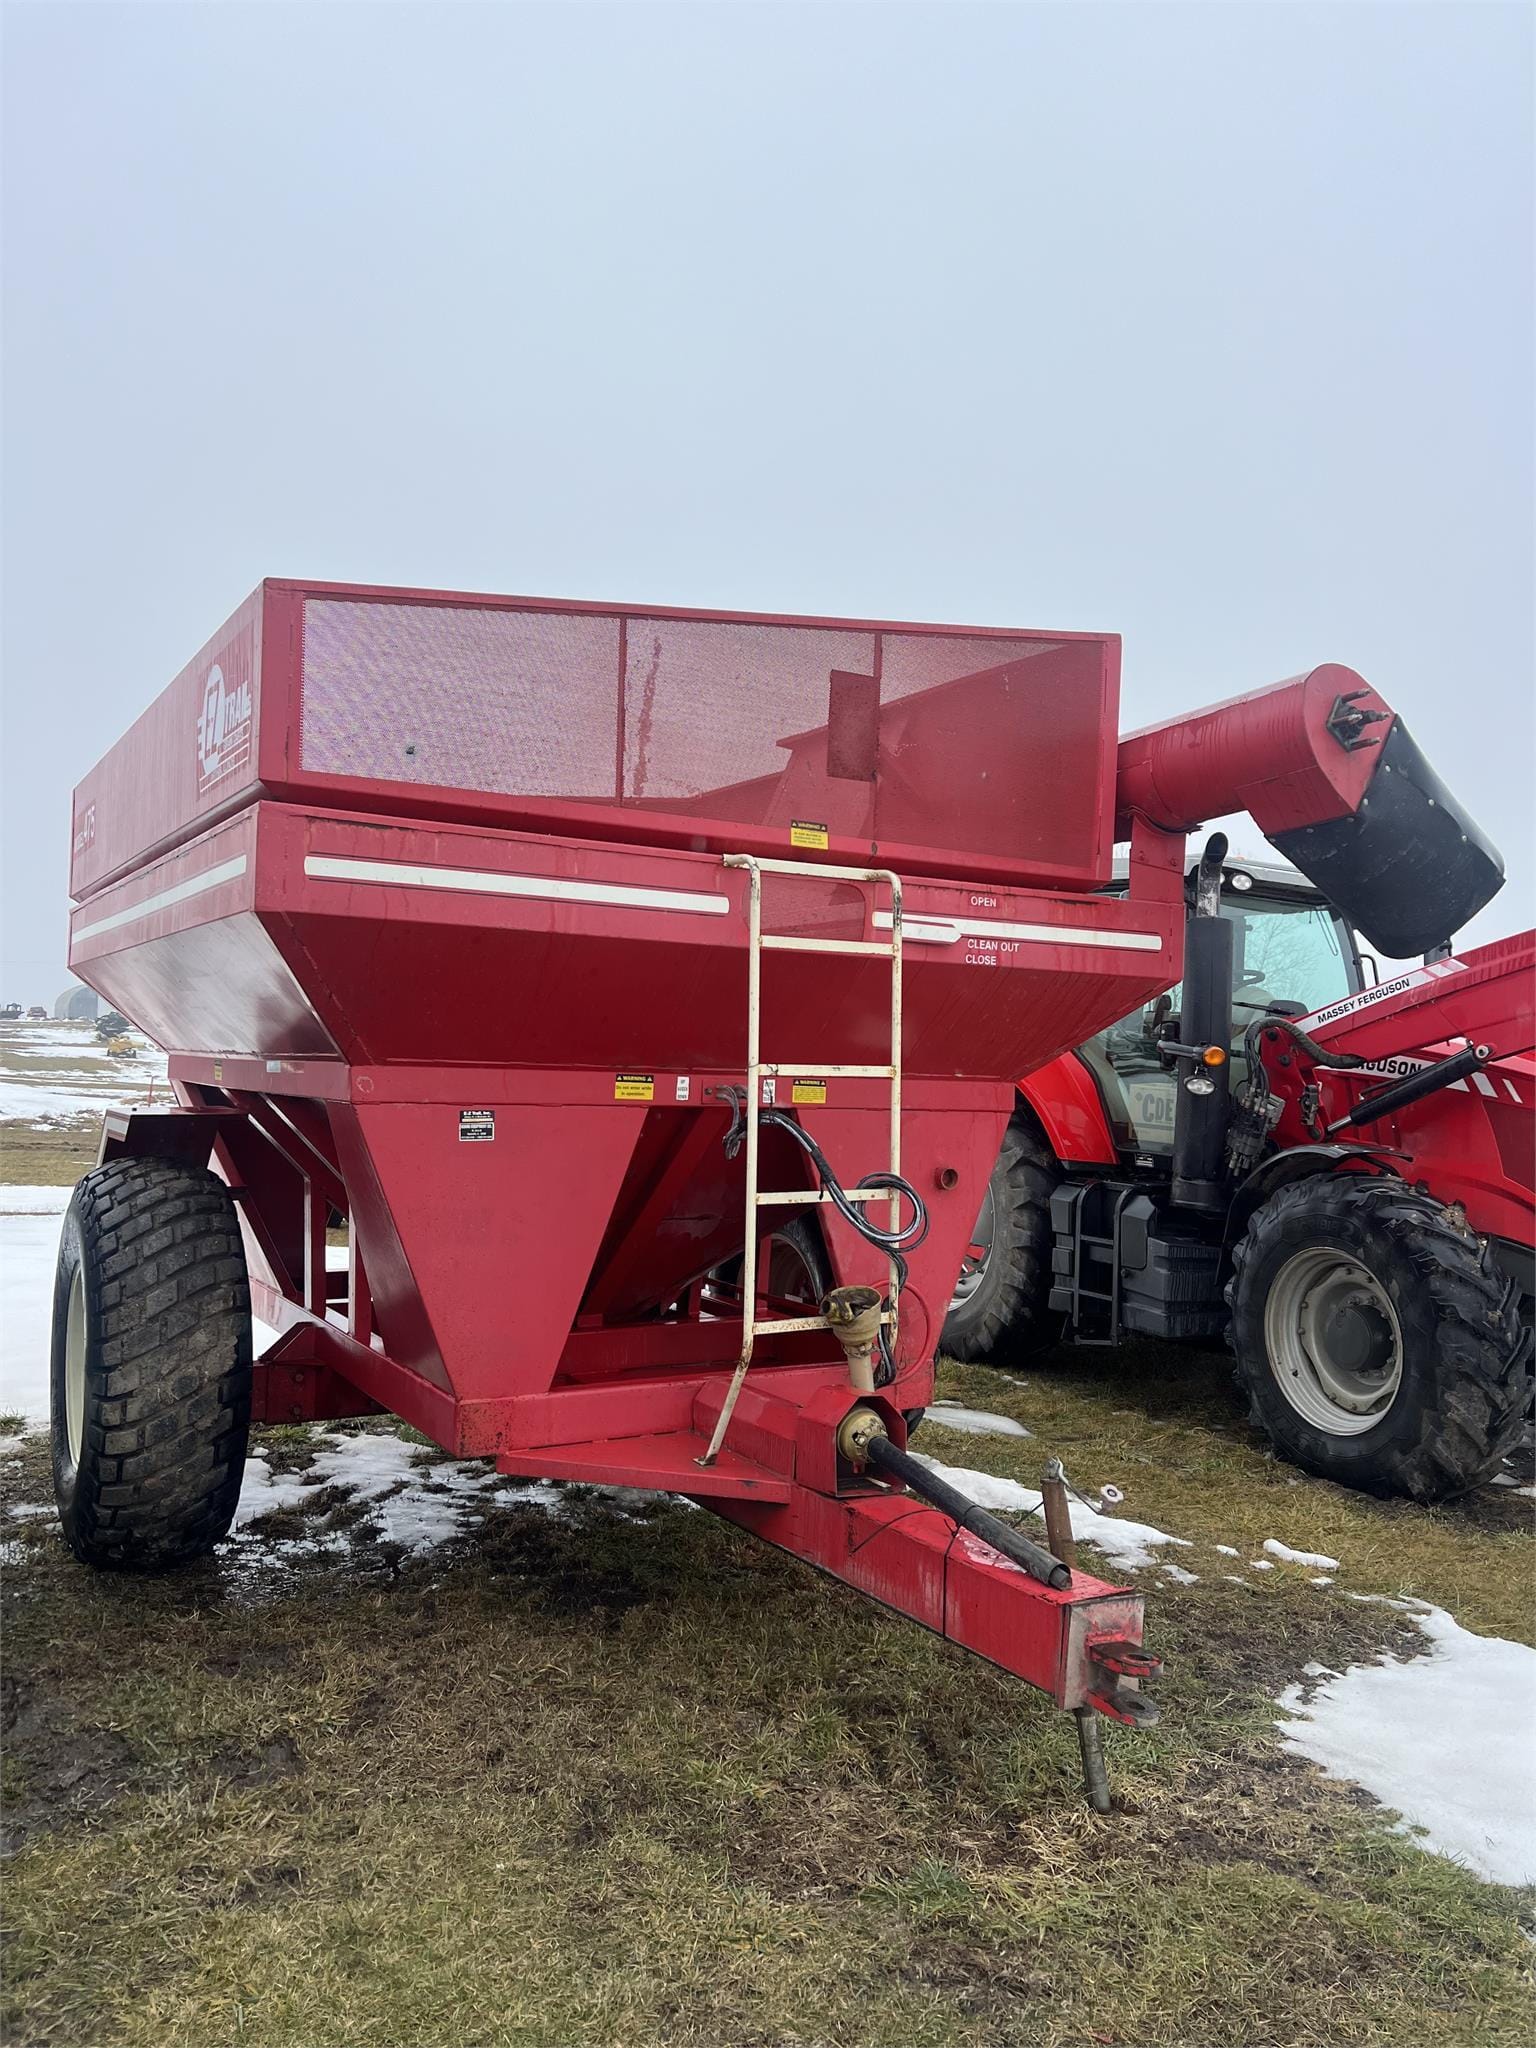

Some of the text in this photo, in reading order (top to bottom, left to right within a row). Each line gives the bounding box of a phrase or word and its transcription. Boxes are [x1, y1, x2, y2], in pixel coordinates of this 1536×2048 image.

[970, 896, 997, 907] OPEN
[967, 938, 1020, 952] CLEAN OUT
[965, 954, 997, 965] CLOSE
[1317, 978, 1410, 1024] MASSEY FERGUSON
